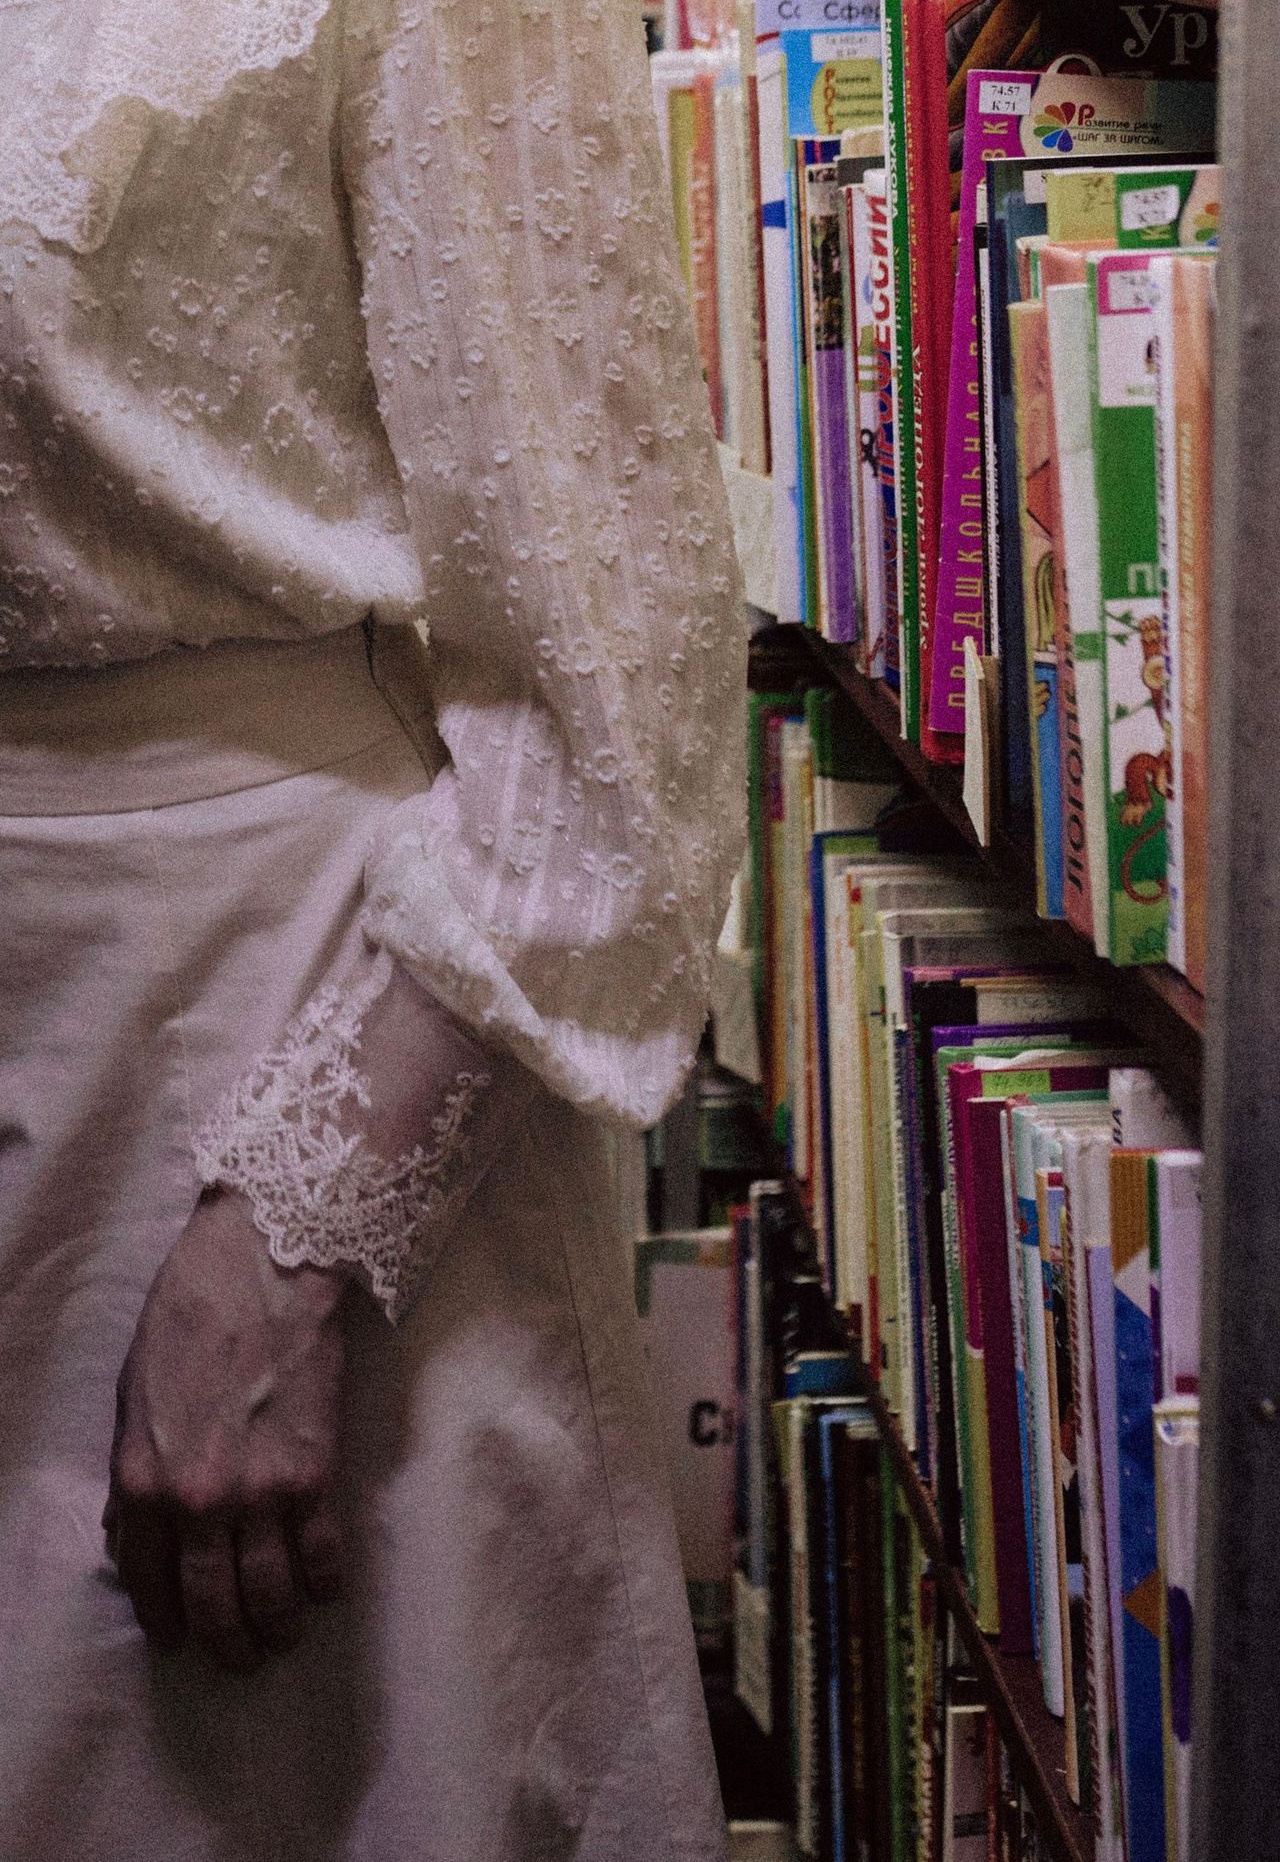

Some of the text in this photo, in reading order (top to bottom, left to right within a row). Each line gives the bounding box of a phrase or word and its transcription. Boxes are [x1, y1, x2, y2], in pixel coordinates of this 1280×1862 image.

[990, 85, 1021, 97] 74.57
[1077, 103, 1131, 131] Развитие
[888, 121, 898, 219] ЖУКОВА
[866, 195, 896, 488] ПРОФЕССИИ
[911, 344, 931, 651] Уроки ЛОГОПЕДА
